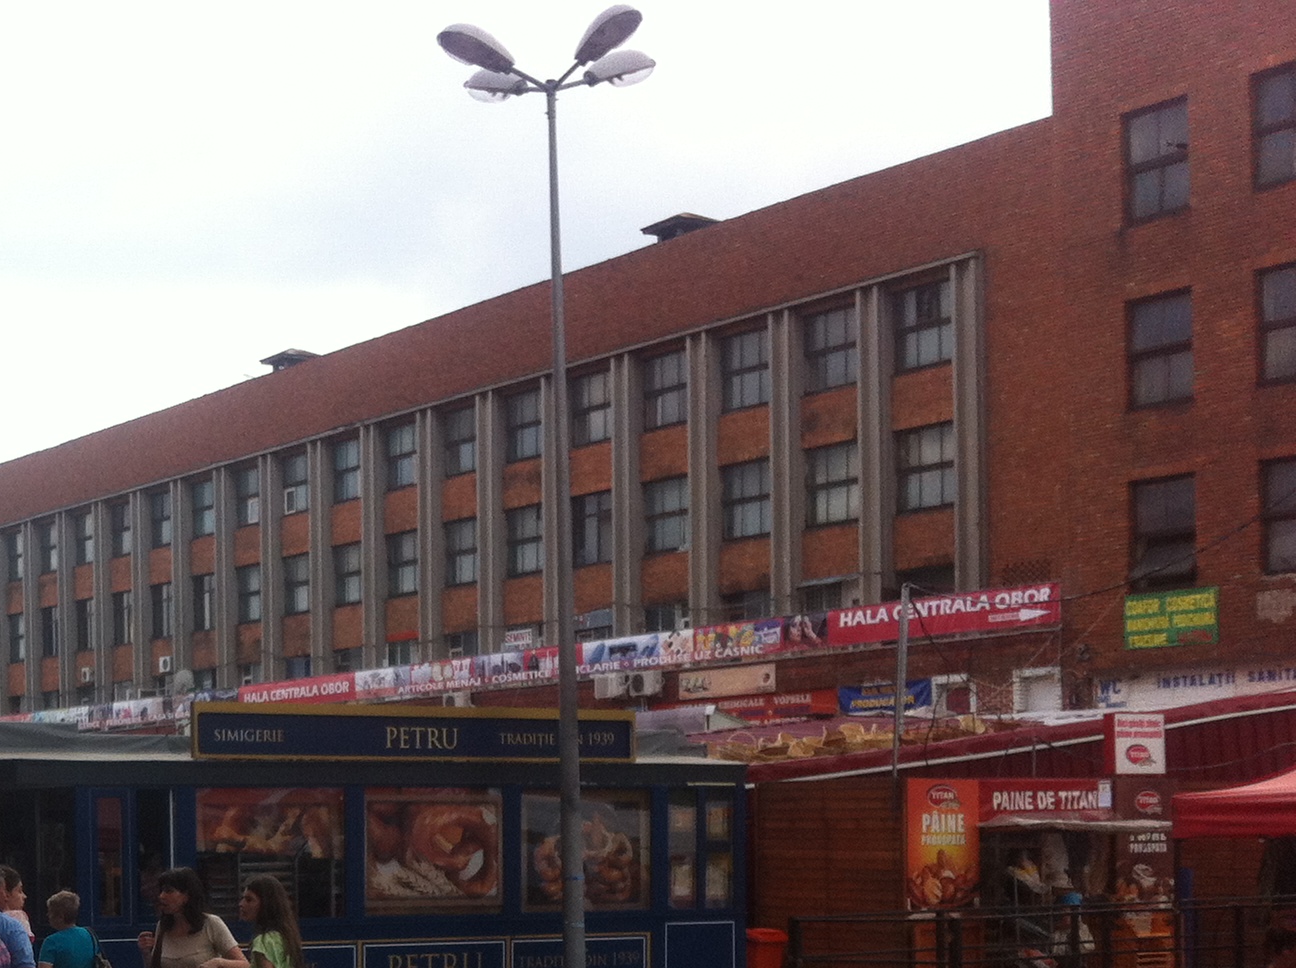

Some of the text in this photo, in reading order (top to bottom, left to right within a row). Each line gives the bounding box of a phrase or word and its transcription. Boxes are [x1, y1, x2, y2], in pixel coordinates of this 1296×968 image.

[839, 606, 889, 628] HALA
[893, 594, 992, 621] CENTRALA
[994, 586, 1052, 610] OBOR
[397, 680, 445, 694] ARTICOLE
[446, 677, 481, 689] MENAJ
[491, 669, 550, 684] COSMETICE
[576, 660, 620, 675] ICLARIE
[633, 651, 691, 668] PRODUSE
[694, 649, 712, 661] UZ
[244, 680, 350, 703] HALA CENTRALA OBOR
[212, 728, 285, 744] SIMIGERIE
[384, 726, 459, 750] PETRU
[588, 731, 615, 746] 1939
[992, 789, 1100, 811] PAINE DE TITAN
[612, 950, 640, 965] 1939
